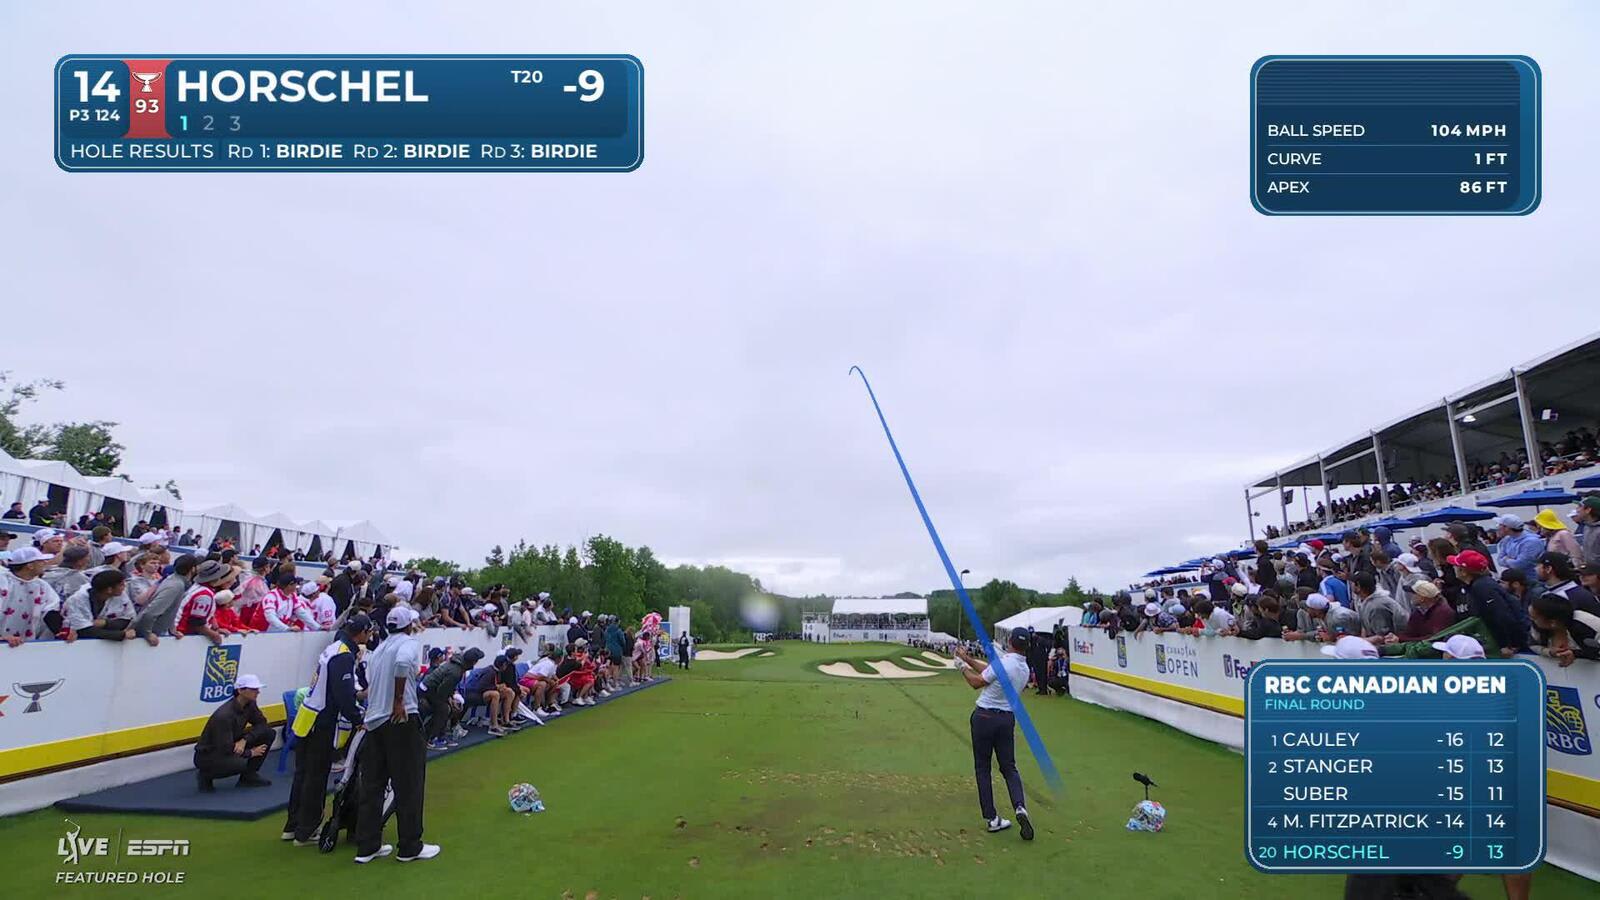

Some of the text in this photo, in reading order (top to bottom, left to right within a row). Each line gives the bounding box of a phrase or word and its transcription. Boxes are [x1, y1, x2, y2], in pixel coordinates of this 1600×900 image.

[1167, 658, 1198, 677] OPEN
[203, 684, 233, 699] RBC
[1547, 731, 1588, 752] RBC
